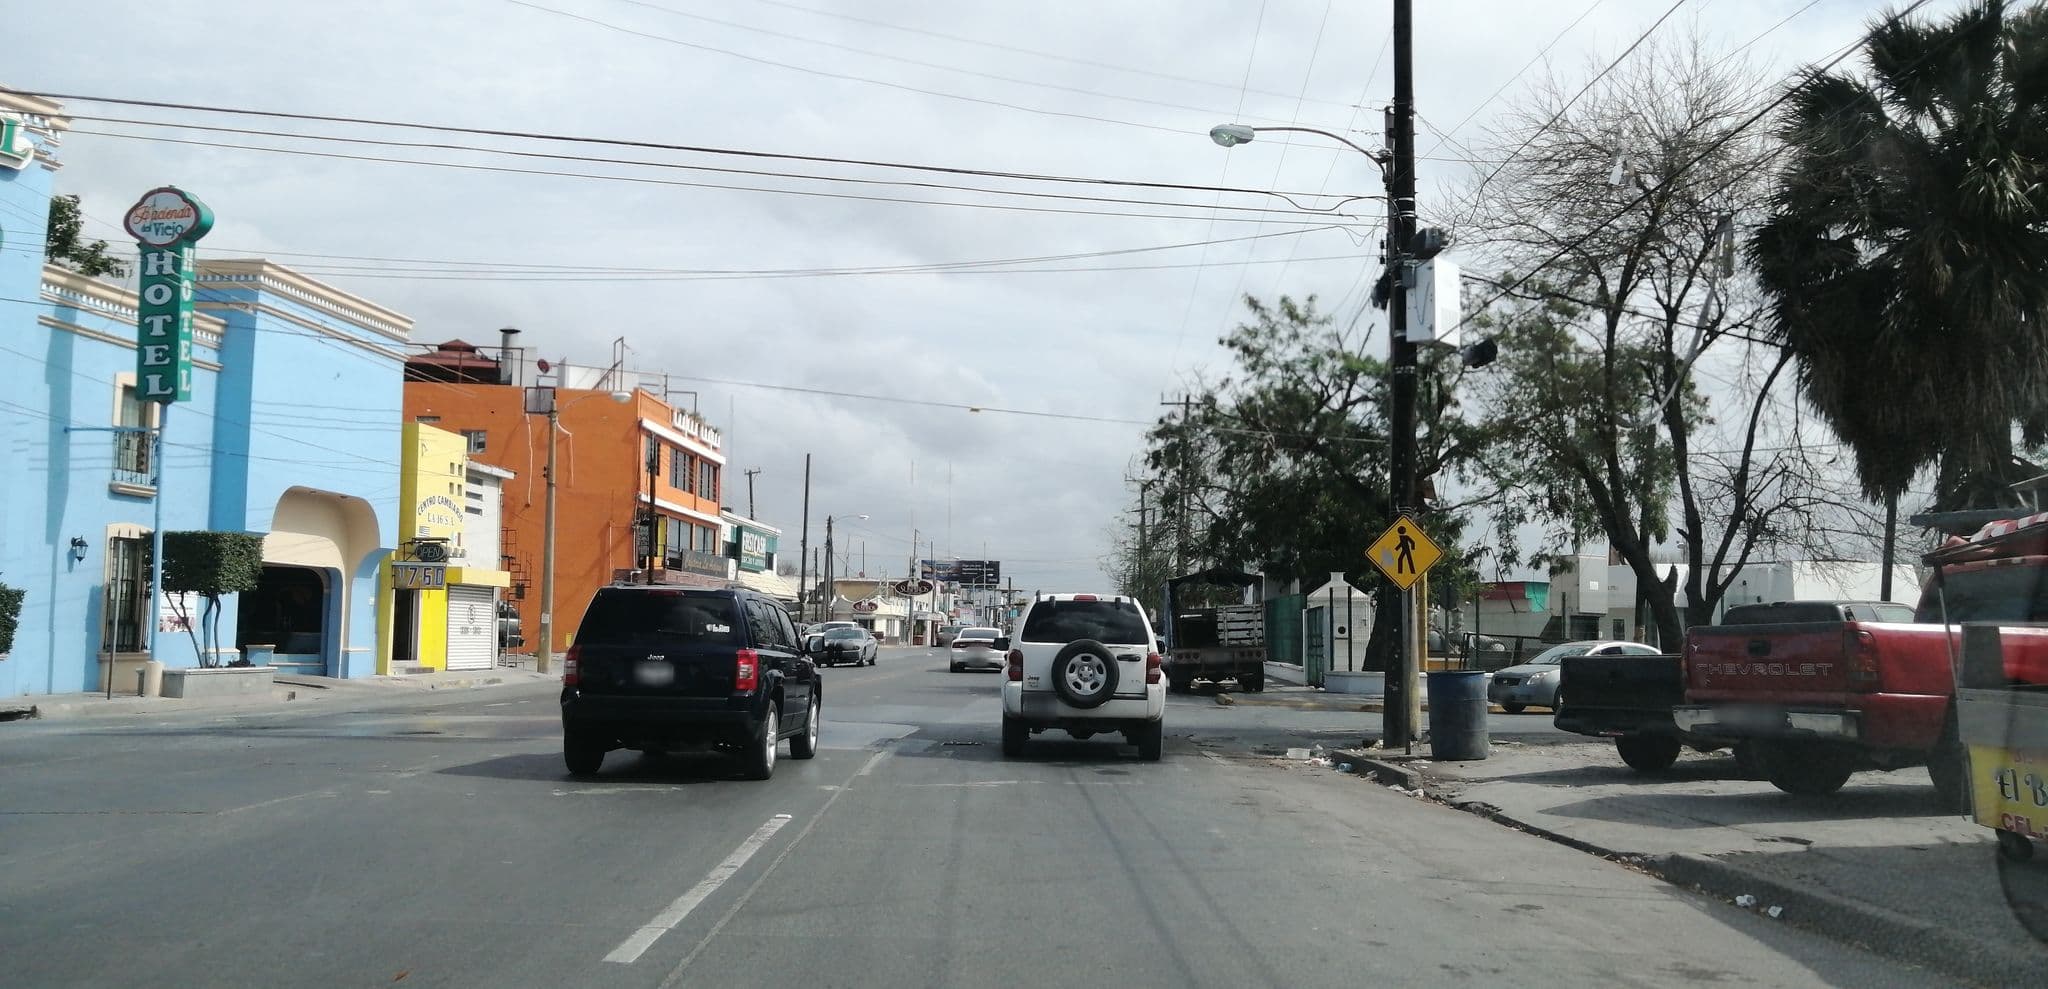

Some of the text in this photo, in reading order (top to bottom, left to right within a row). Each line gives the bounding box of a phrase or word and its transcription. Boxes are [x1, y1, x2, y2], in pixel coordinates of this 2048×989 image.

[153, 222, 184, 239] Viejo
[144, 252, 177, 396] HOTEL
[180, 247, 194, 392] HOTEL
[1696, 663, 1833, 677] CHEVROLET
